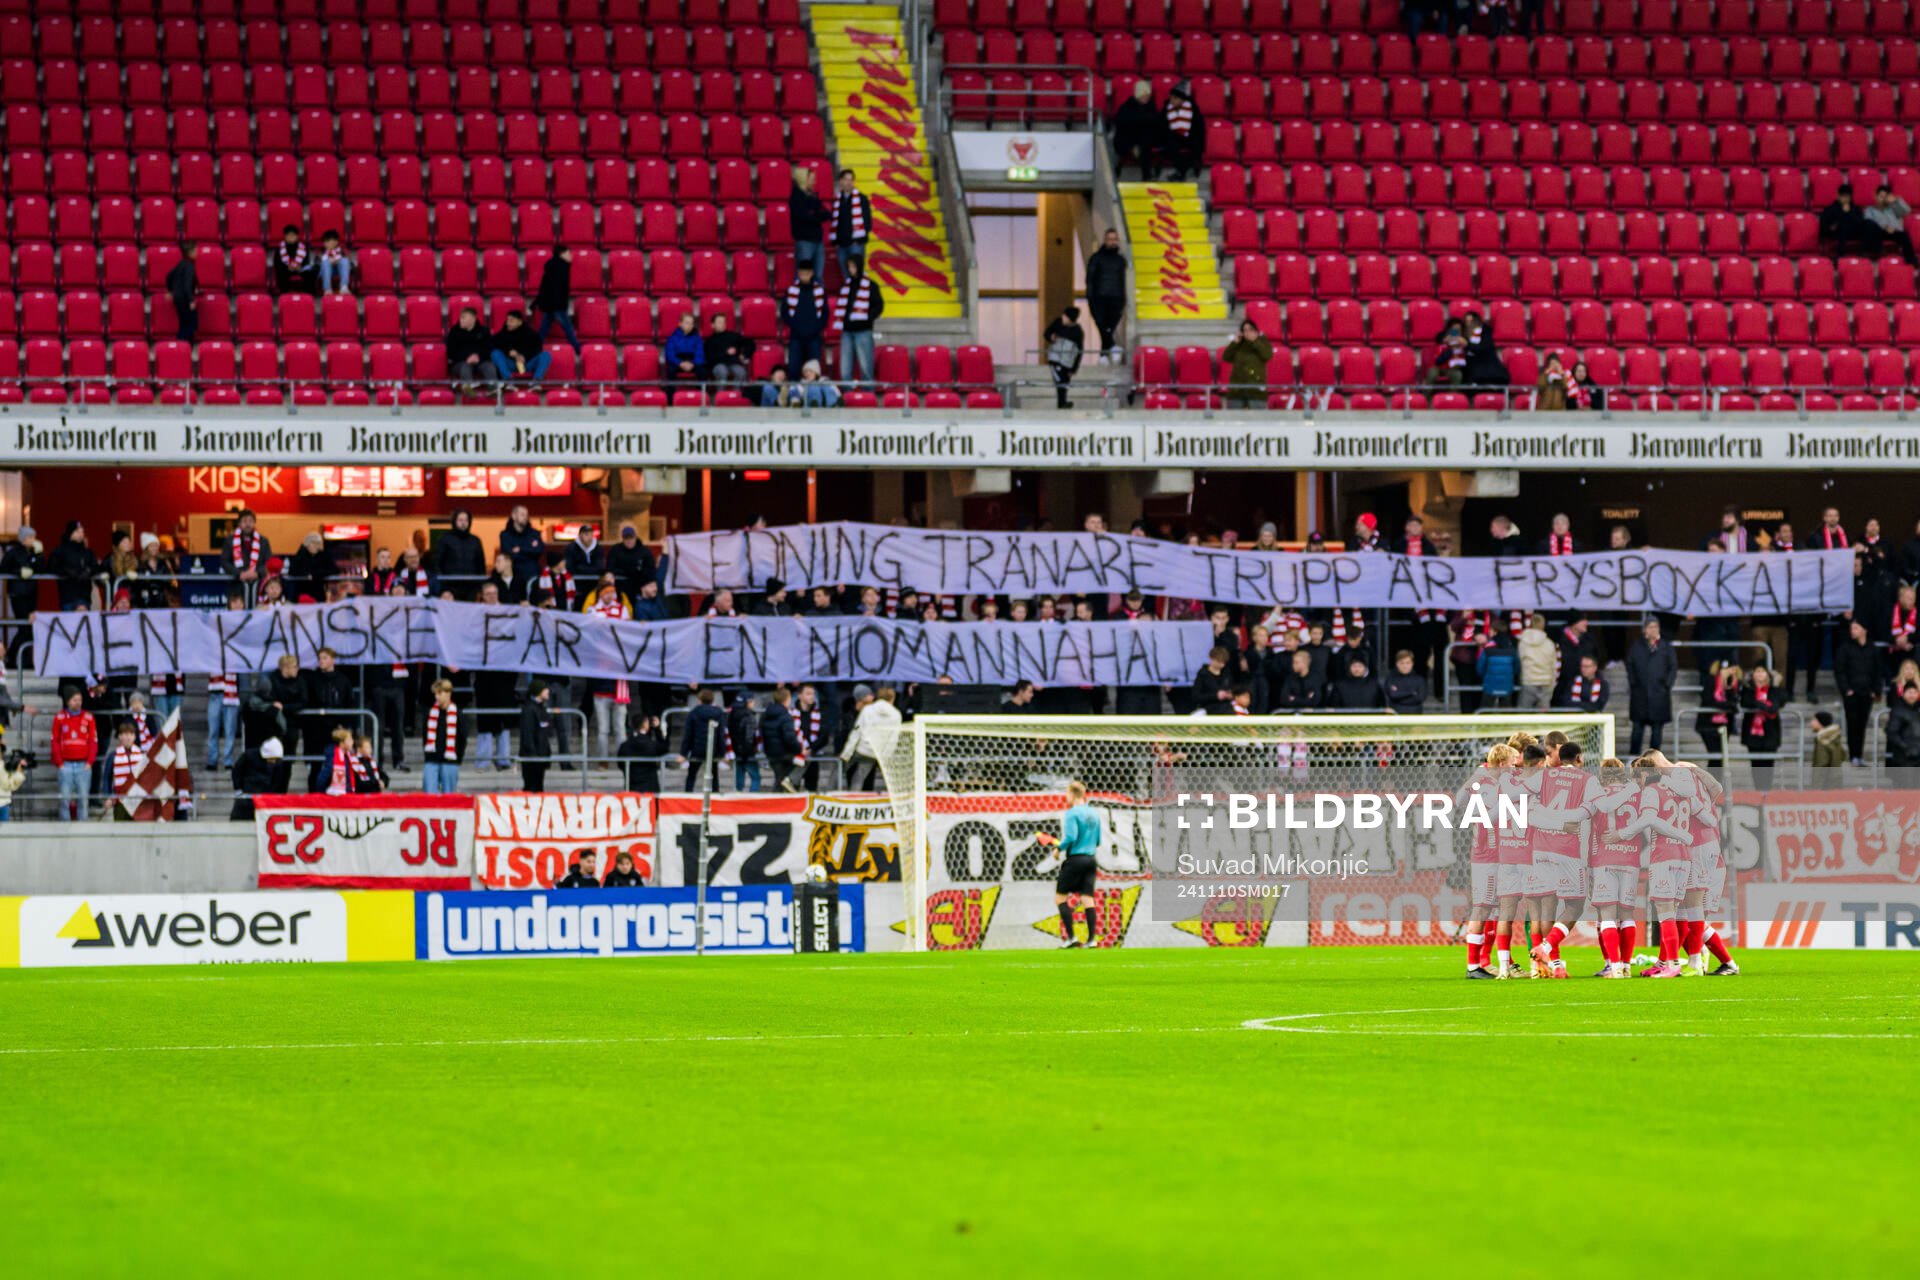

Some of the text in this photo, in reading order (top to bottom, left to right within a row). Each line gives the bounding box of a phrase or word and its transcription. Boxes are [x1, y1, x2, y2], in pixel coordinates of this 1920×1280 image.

[14, 424, 158, 450] Barometern
[181, 426, 323, 452] Barometern
[347, 427, 488, 453] Barometern
[512, 428, 651, 453] Barometern
[675, 429, 813, 454] Barometern
[836, 430, 974, 455] Barometern
[998, 431, 1133, 456] Barometern
[1154, 432, 1290, 457] Barometern
[1313, 432, 1448, 457] Barometern
[1472, 433, 1606, 457] Barometern
[1628, 433, 1763, 458] Barometern
[1786, 433, 1920, 458] Barometern
[189, 467, 284, 494] KIOSK
[671, 526, 1851, 614] LEDNING TRÄNARE TRUPP ÄR FRYSBOXKALL
[40, 611, 178, 676] MEN
[216, 605, 439, 675] KANSKE
[610, 624, 667, 678] VI
[703, 621, 767, 680] EN
[809, 624, 1190, 686] NIOMANNAHALL
[478, 796, 653, 838] KURVAN
[816, 804, 850, 820] TIFO
[1768, 808, 1850, 832] brothers
[265, 814, 459, 868] RC 23
[676, 822, 793, 886] 24
[944, 818, 1063, 883] 20
[1775, 831, 1846, 883] red
[114, 900, 311, 947] weber
[814, 898, 829, 952] SELECT
